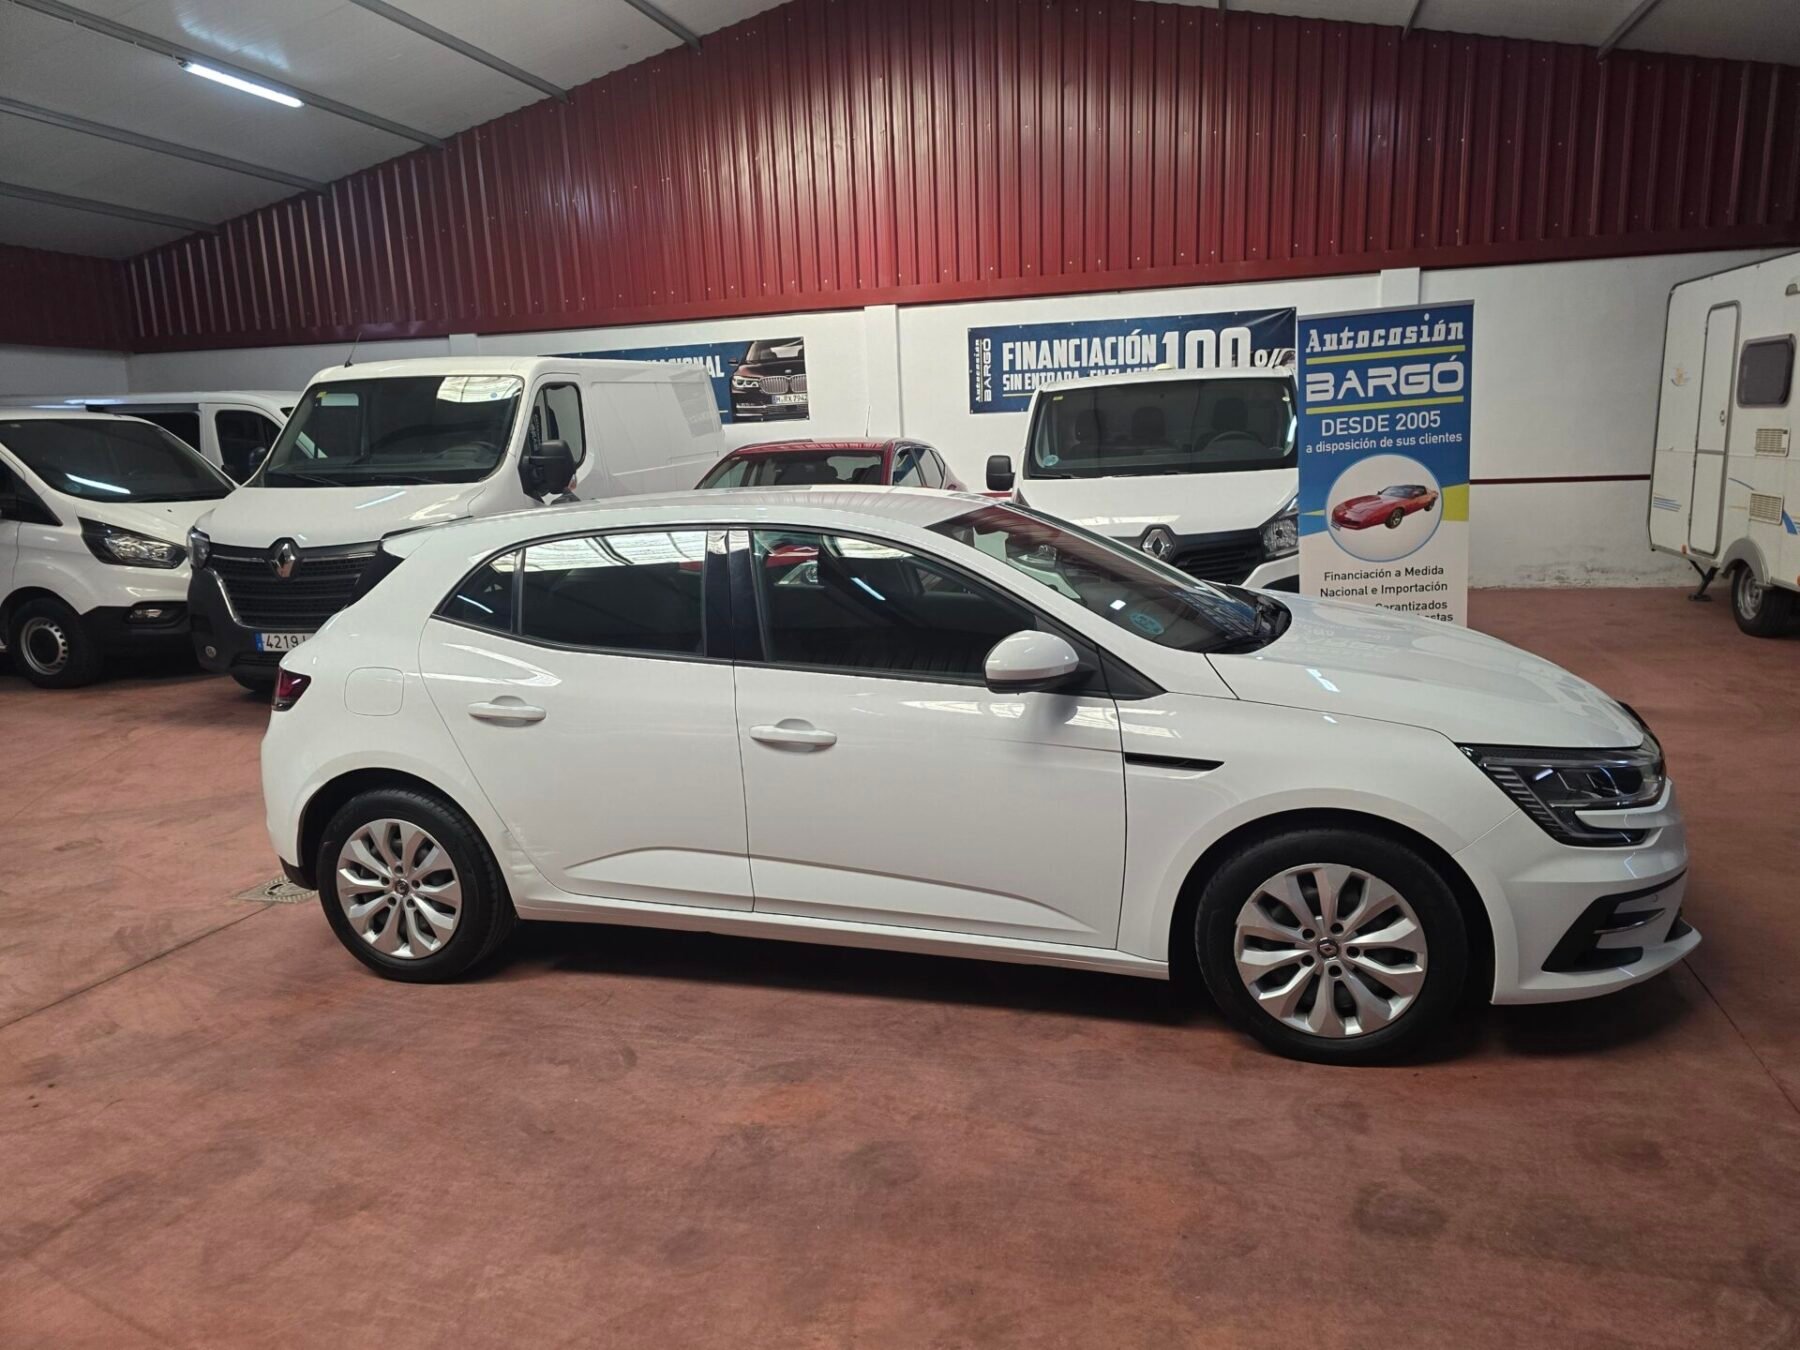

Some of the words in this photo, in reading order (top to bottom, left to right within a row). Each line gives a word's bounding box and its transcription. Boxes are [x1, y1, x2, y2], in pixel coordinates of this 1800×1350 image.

[1306, 313, 1463, 353] Autocasión
[1002, 329, 1157, 371] FINANCIACIÓN
[1002, 373, 1023, 391] SIN
[1306, 355, 1464, 402] BARGÓ
[1321, 414, 1390, 437] DESDE
[1395, 410, 1441, 431] 2005
[1306, 444, 1313, 454] a
[1315, 437, 1377, 454] disposición
[1379, 436, 1393, 448] de
[1396, 434, 1416, 446] sus
[1418, 432, 1463, 444] clientes
[1324, 568, 1391, 581] Financiación
[1394, 569, 1402, 577] a
[1404, 565, 1444, 577] Medida
[1320, 586, 1368, 598] Nacional
[1370, 586, 1378, 595] e
[1381, 581, 1448, 595] Importación
[266, 634, 299, 649] 4219
